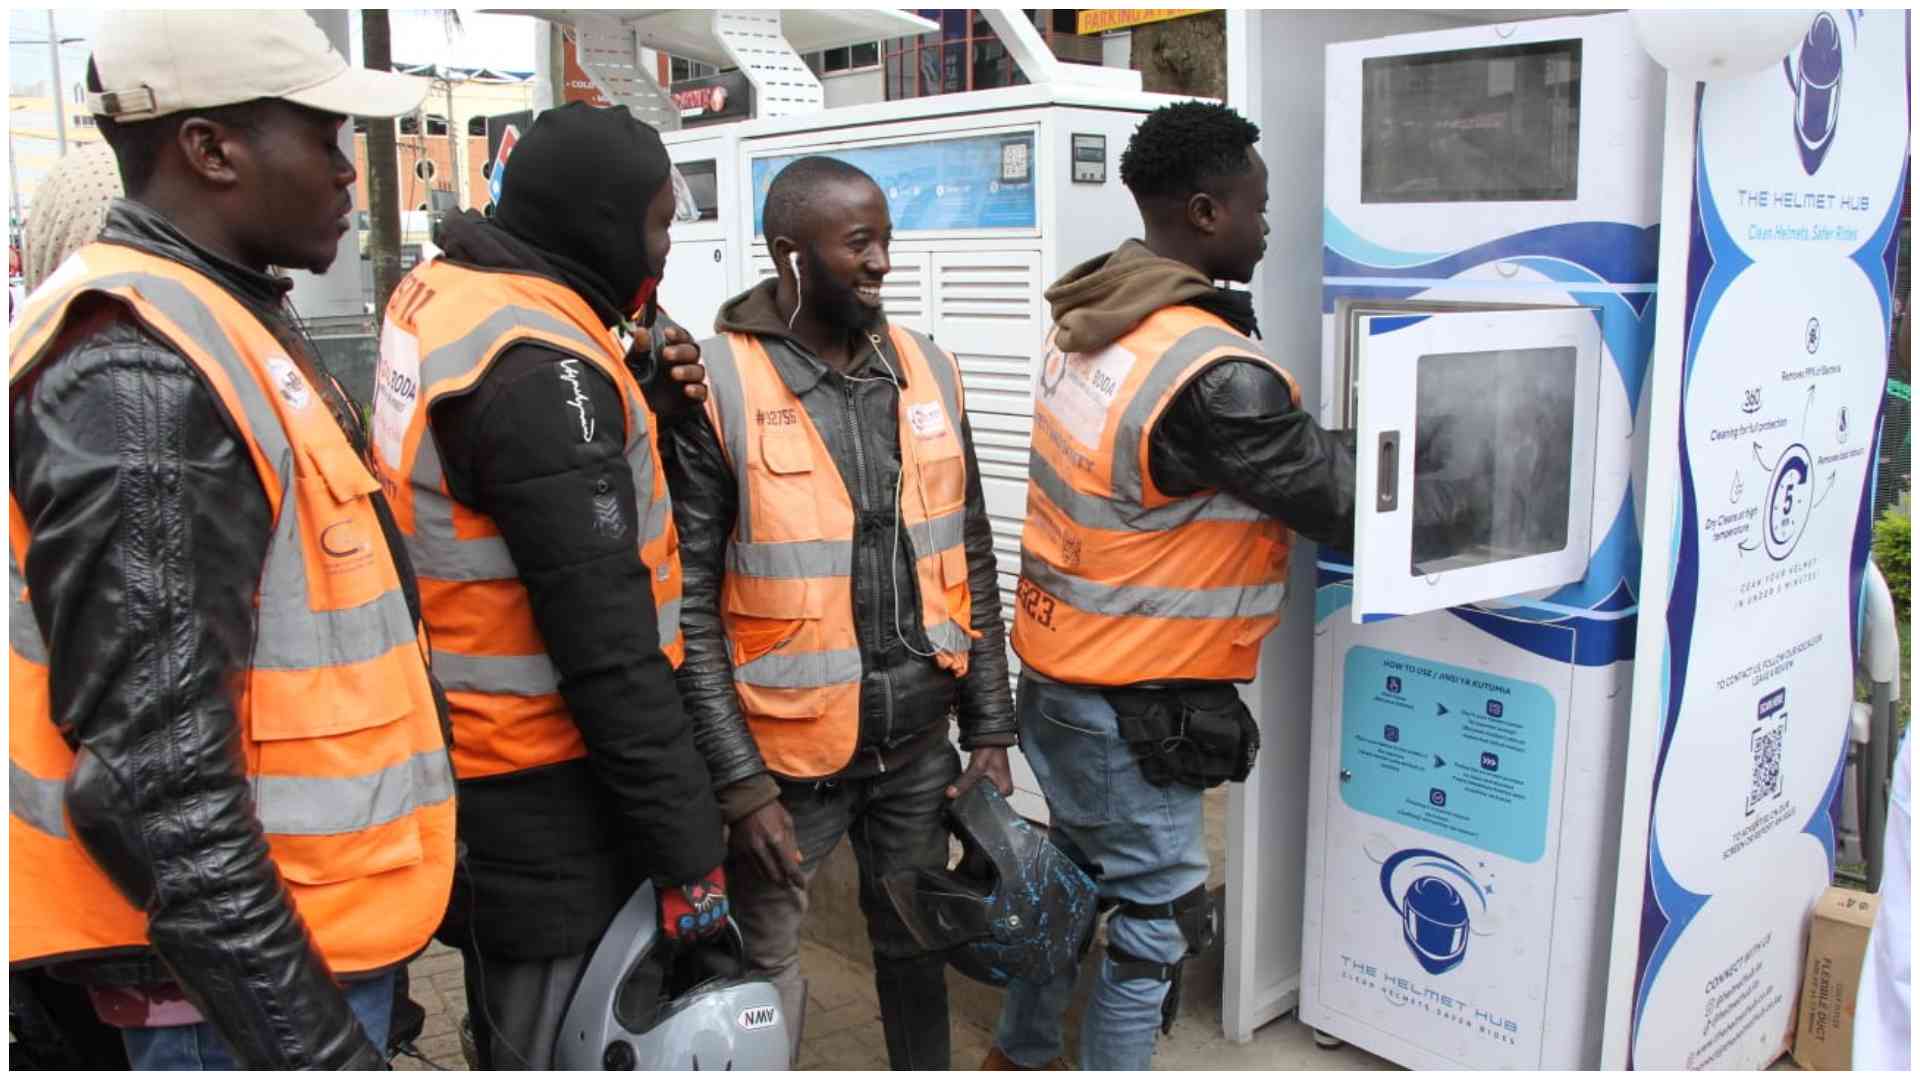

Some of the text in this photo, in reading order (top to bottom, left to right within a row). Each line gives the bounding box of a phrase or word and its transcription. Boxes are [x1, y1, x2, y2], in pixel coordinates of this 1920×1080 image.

[1738, 189, 1869, 211] THE HELMET HUB
[1783, 483, 1794, 515] 5
[1383, 659, 1403, 670] HOW
[1405, 664, 1415, 673] TO
[1417, 667, 1432, 678] USE
[1341, 954, 1518, 1033] THE HELMET HUB
[1437, 1008, 1472, 1028] SAFER
[1479, 1025, 1516, 1045] RIDES
